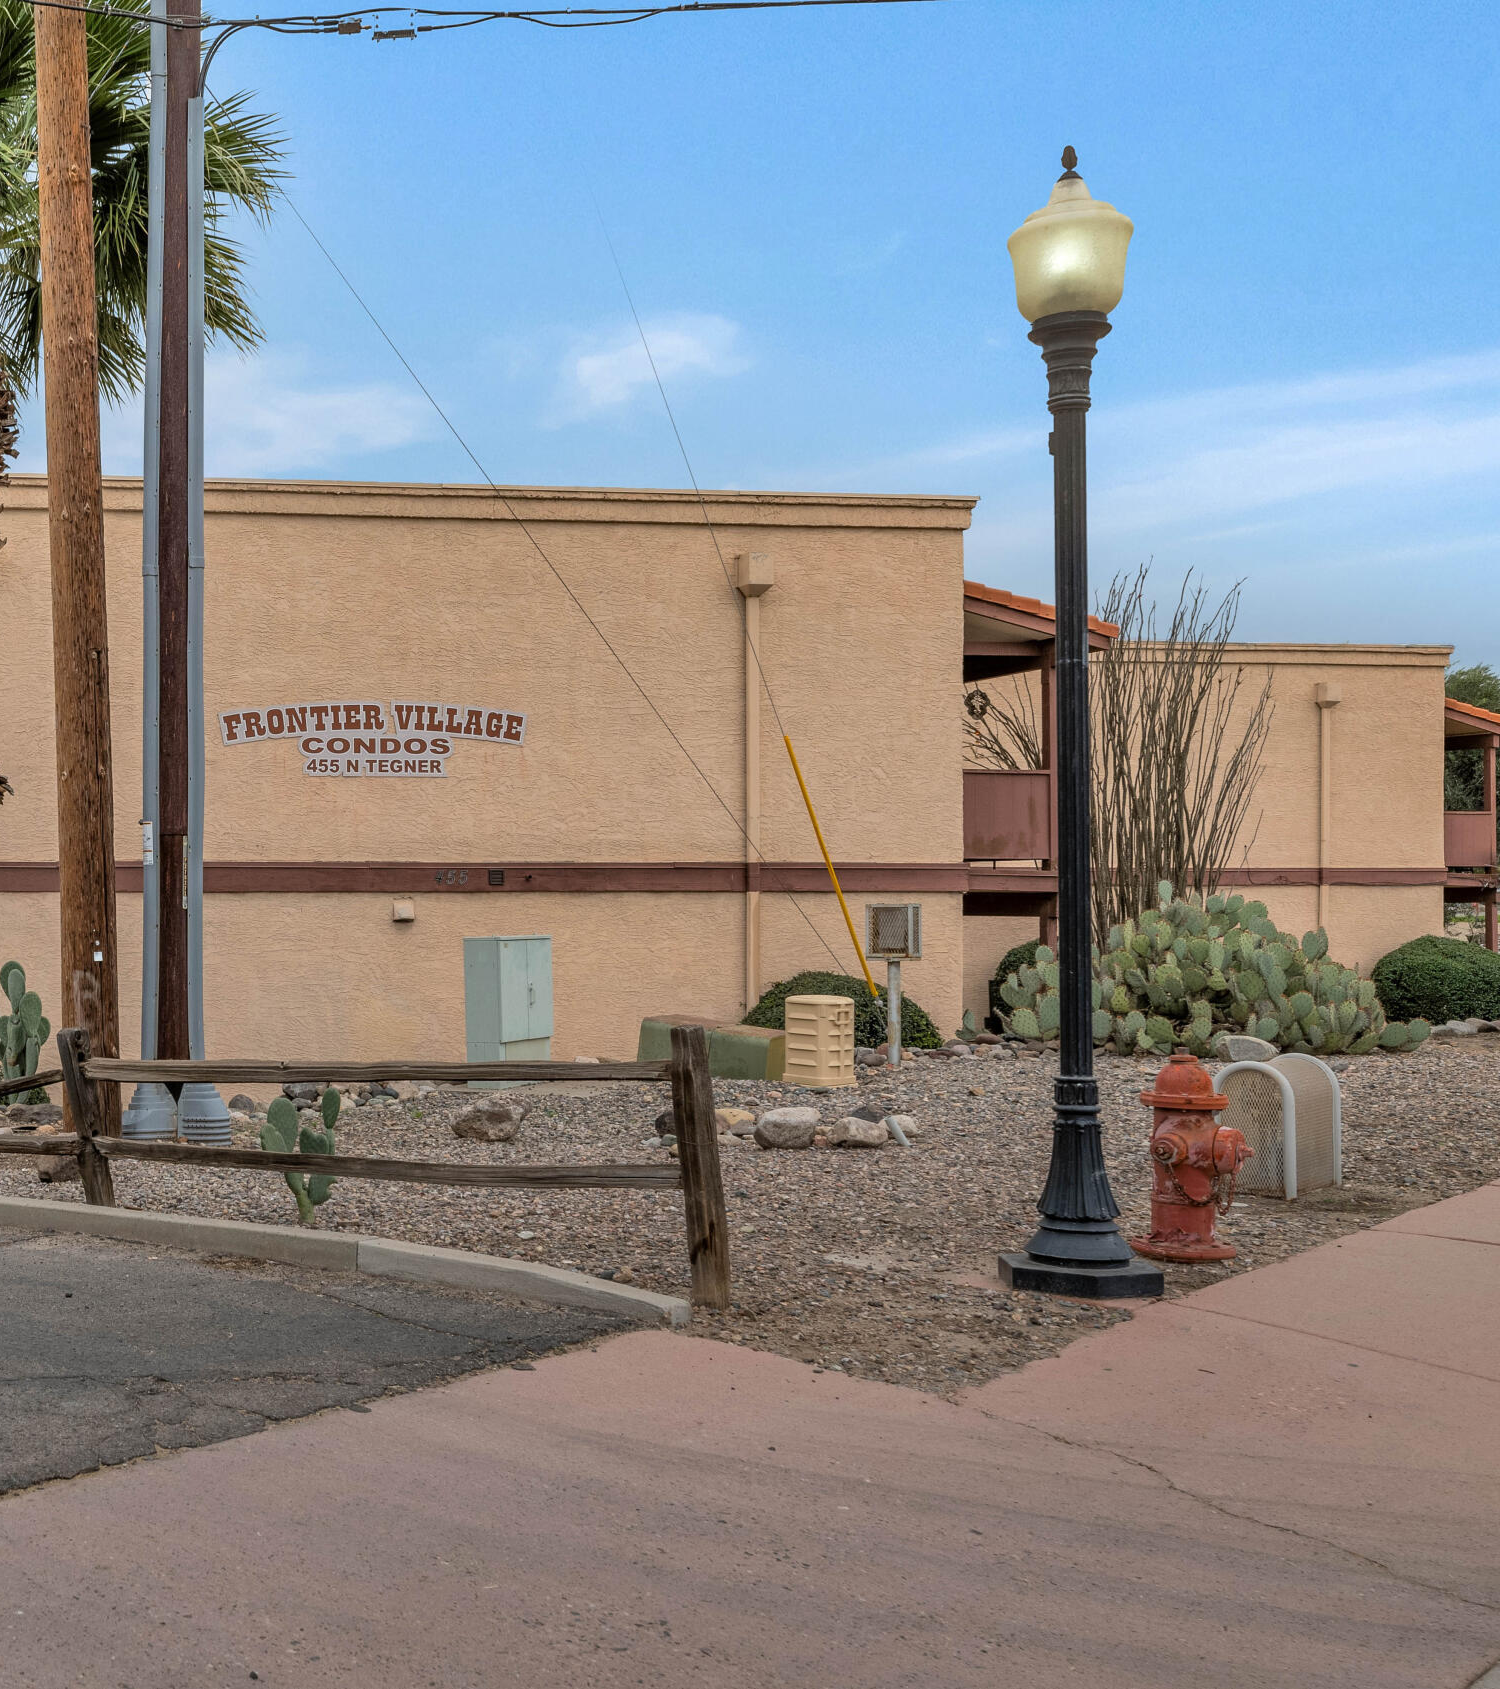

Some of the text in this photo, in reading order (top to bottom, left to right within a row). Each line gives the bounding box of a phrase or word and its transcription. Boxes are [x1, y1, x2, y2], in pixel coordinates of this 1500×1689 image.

[222, 703, 525, 742] FRONTIER VILLAGE
[301, 737, 451, 755] CONDOS
[306, 759, 443, 774] 455 N TEGNER
[434, 869, 469, 885] 455
